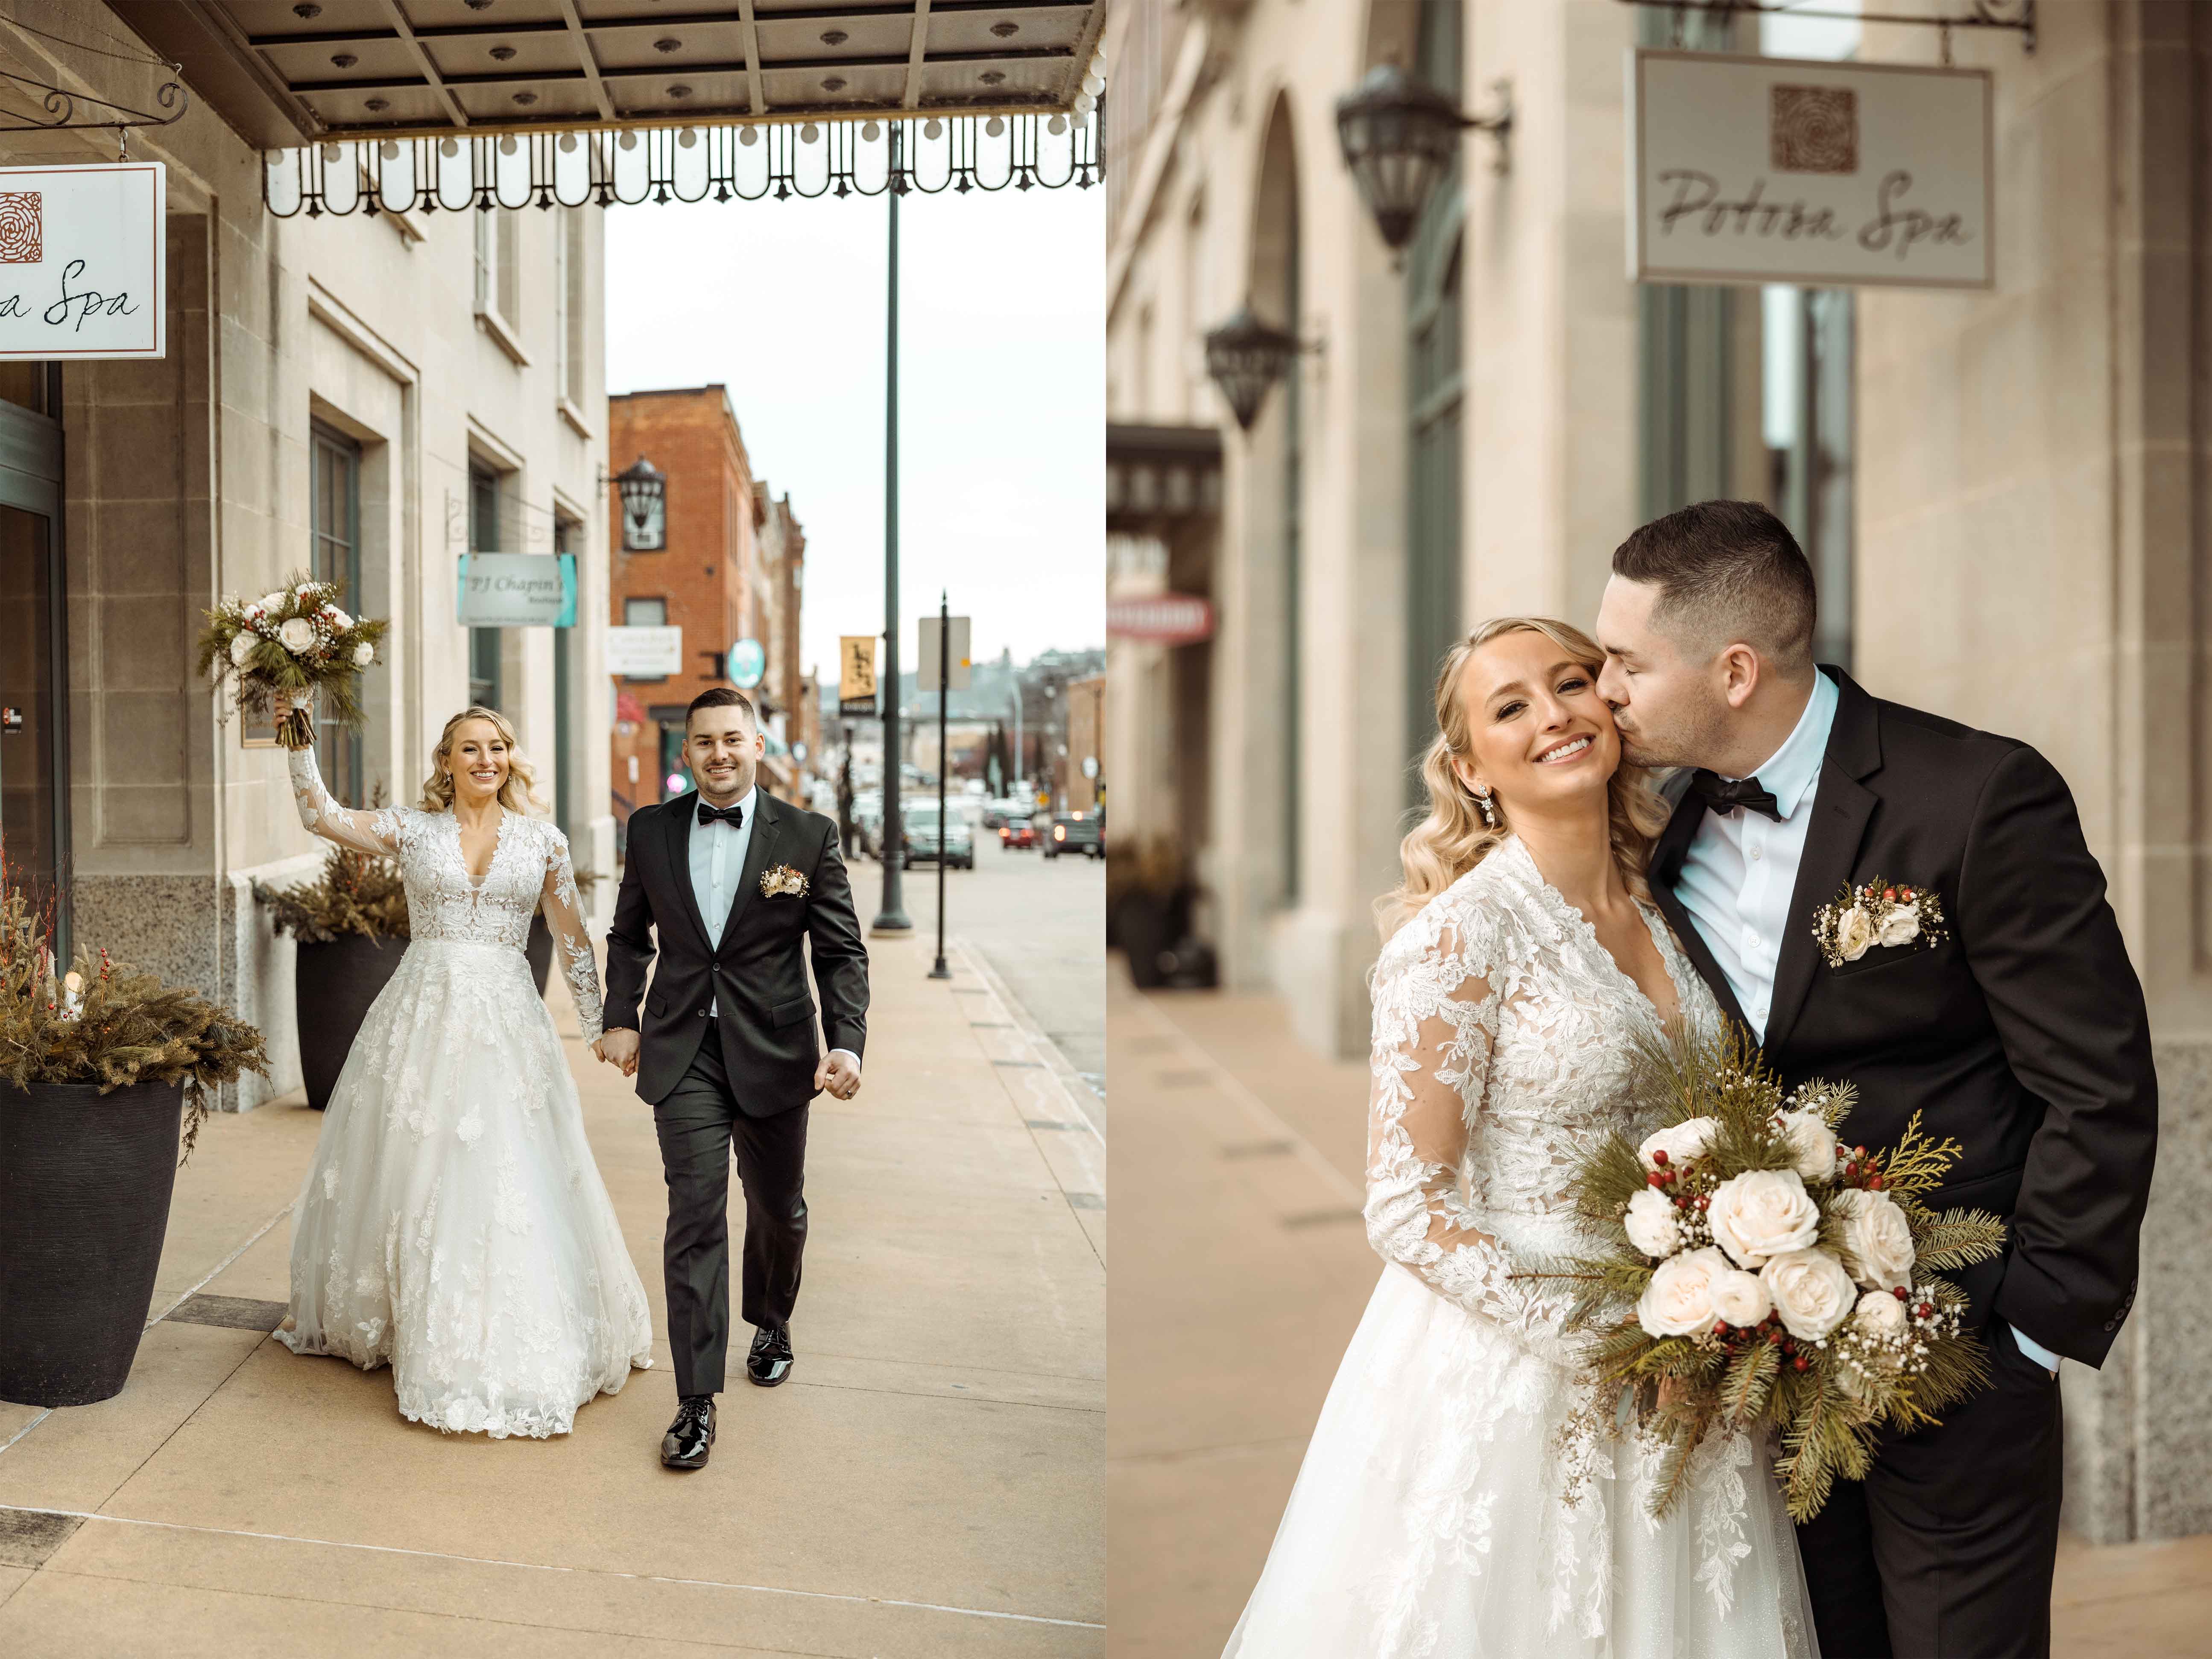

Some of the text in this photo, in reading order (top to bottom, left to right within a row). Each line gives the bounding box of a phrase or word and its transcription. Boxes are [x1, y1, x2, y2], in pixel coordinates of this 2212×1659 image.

[1657, 169, 1975, 261] Potosa Spa
[44, 259, 140, 332] Spa
